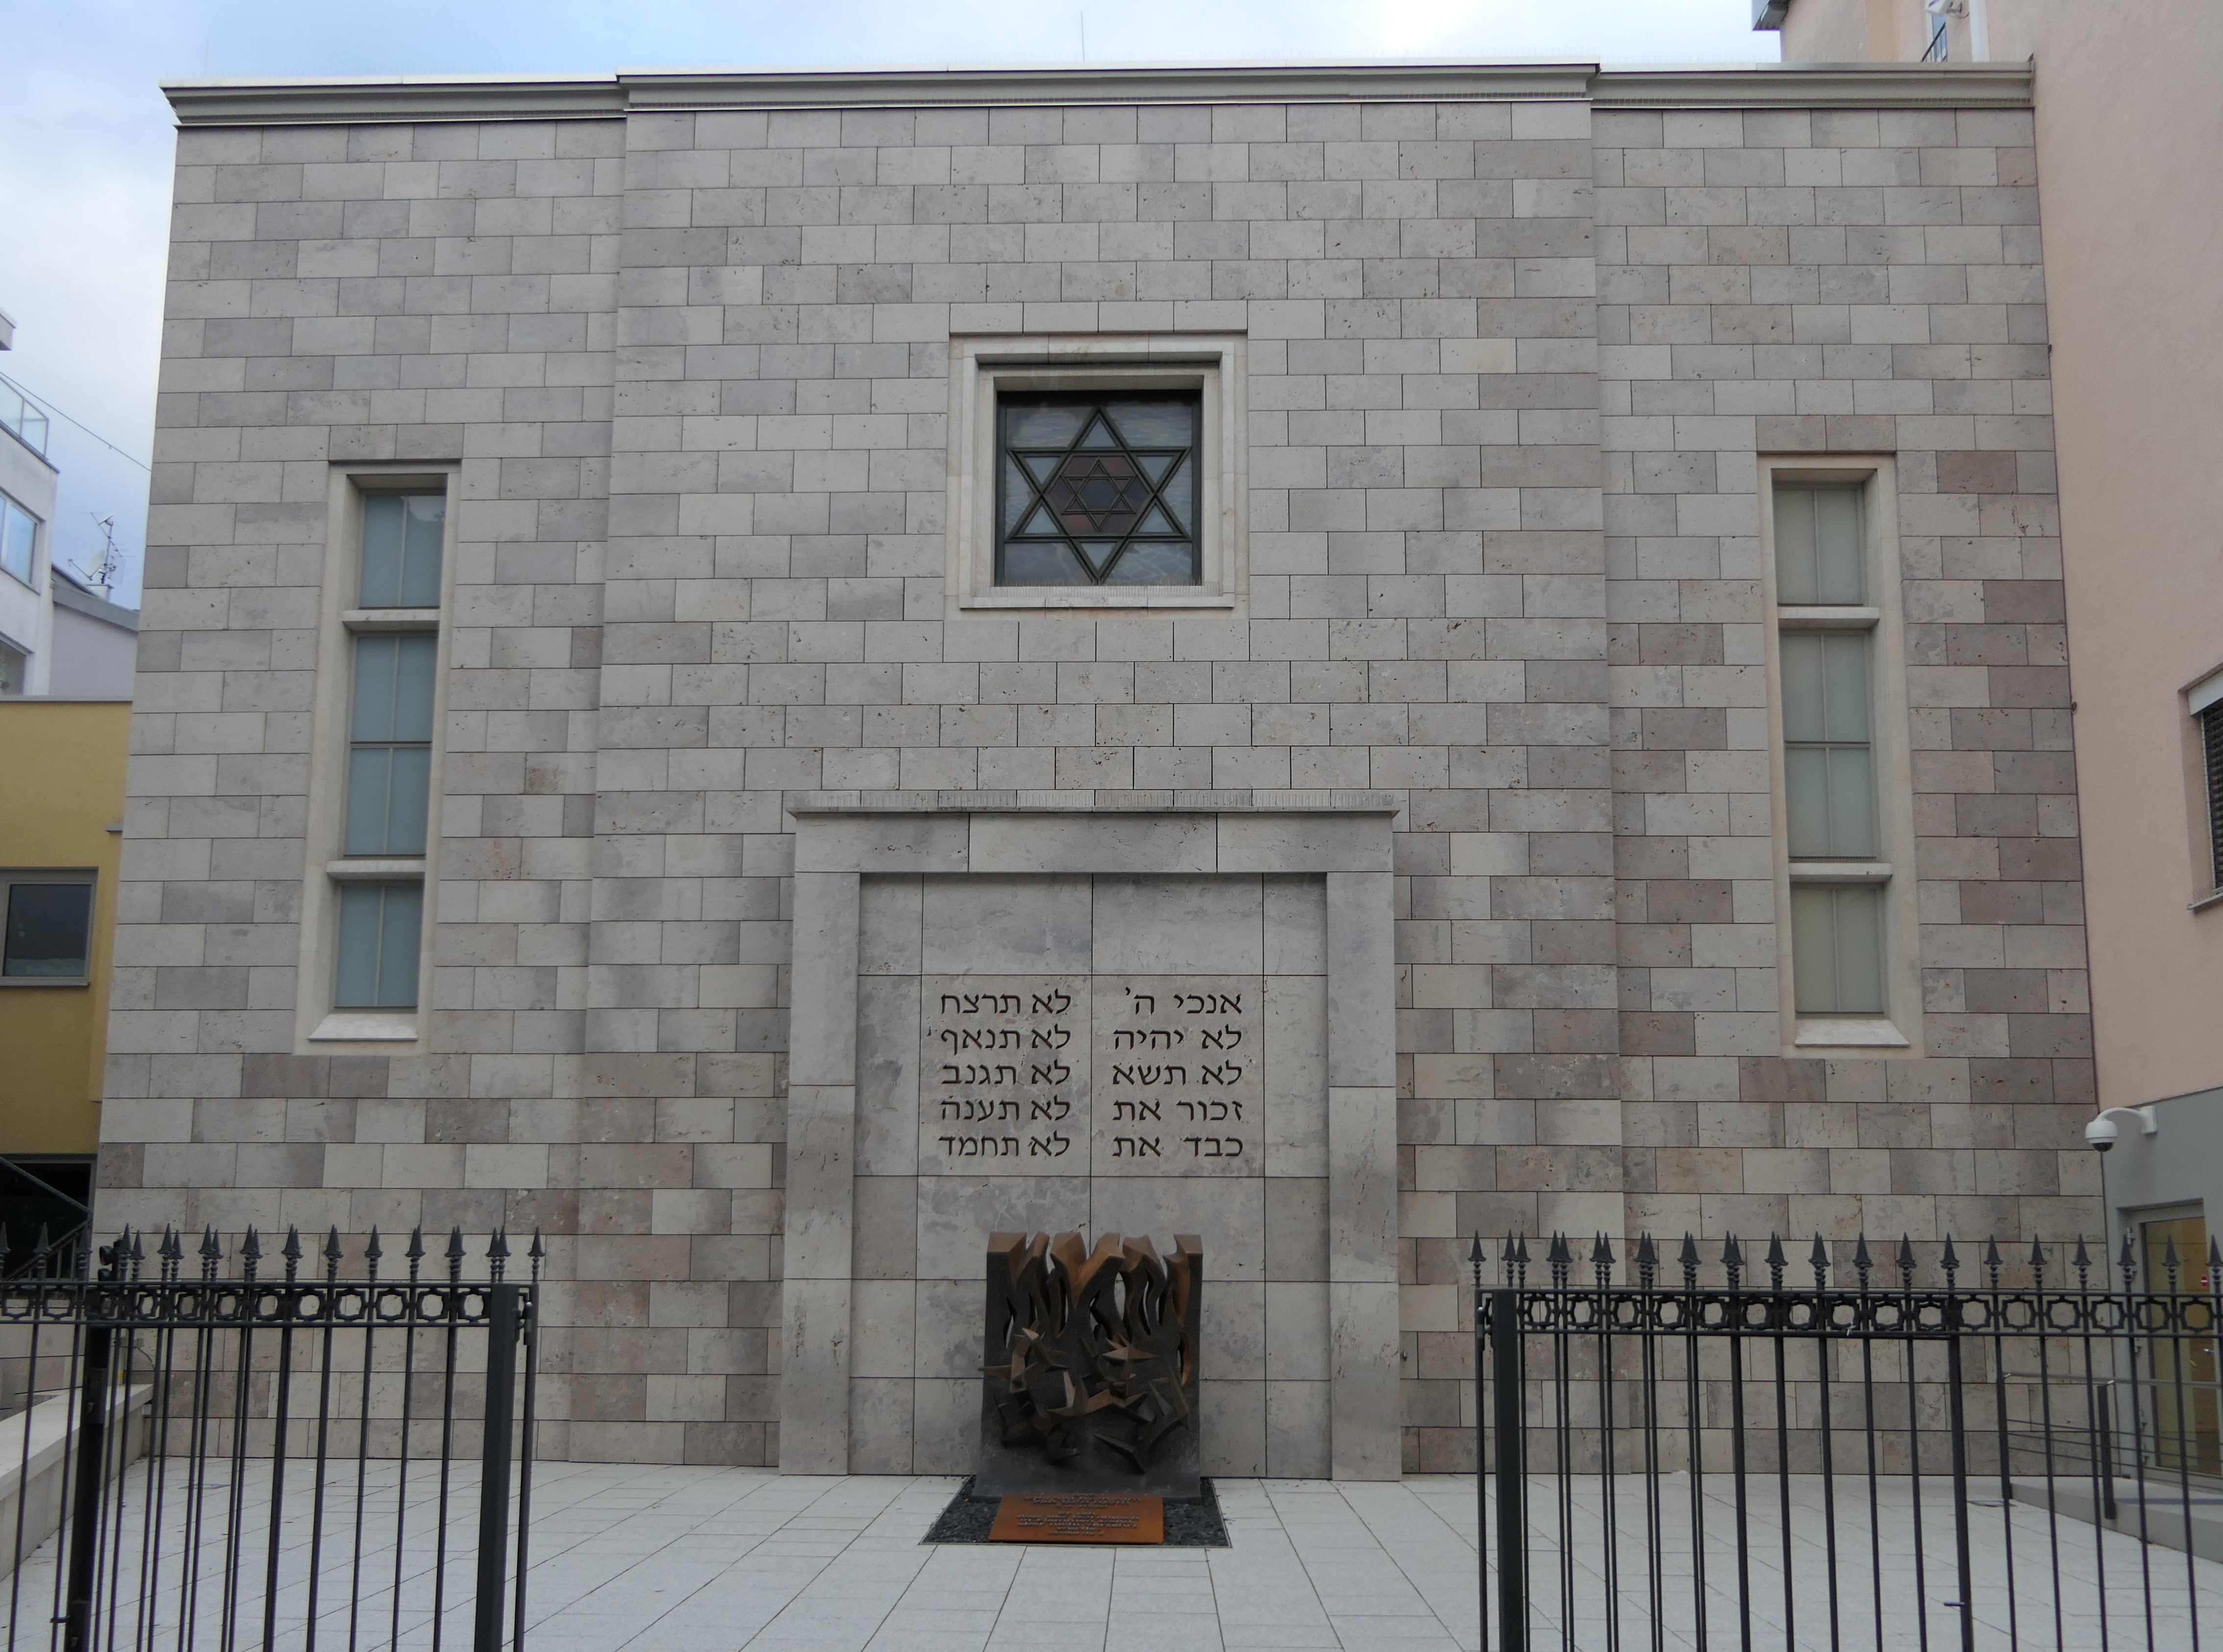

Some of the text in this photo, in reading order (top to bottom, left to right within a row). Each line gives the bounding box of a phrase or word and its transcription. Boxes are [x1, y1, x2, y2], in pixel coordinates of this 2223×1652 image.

[941, 988, 1071, 1015] לא תרצח
[1173, 994, 1242, 1015] אנכי
[941, 1023, 1071, 1056] לא תנאף
[1112, 1023, 1242, 1050] לא יהיה
[941, 1058, 1070, 1085] לא תגנב
[1112, 1059, 1242, 1086] לא תשא
[940, 1094, 1070, 1122] לא תענה
[1112, 1099, 1243, 1122] זכור את
[938, 1130, 1070, 1157] לא תחמד
[1112, 1136, 1243, 1158] כבד את
